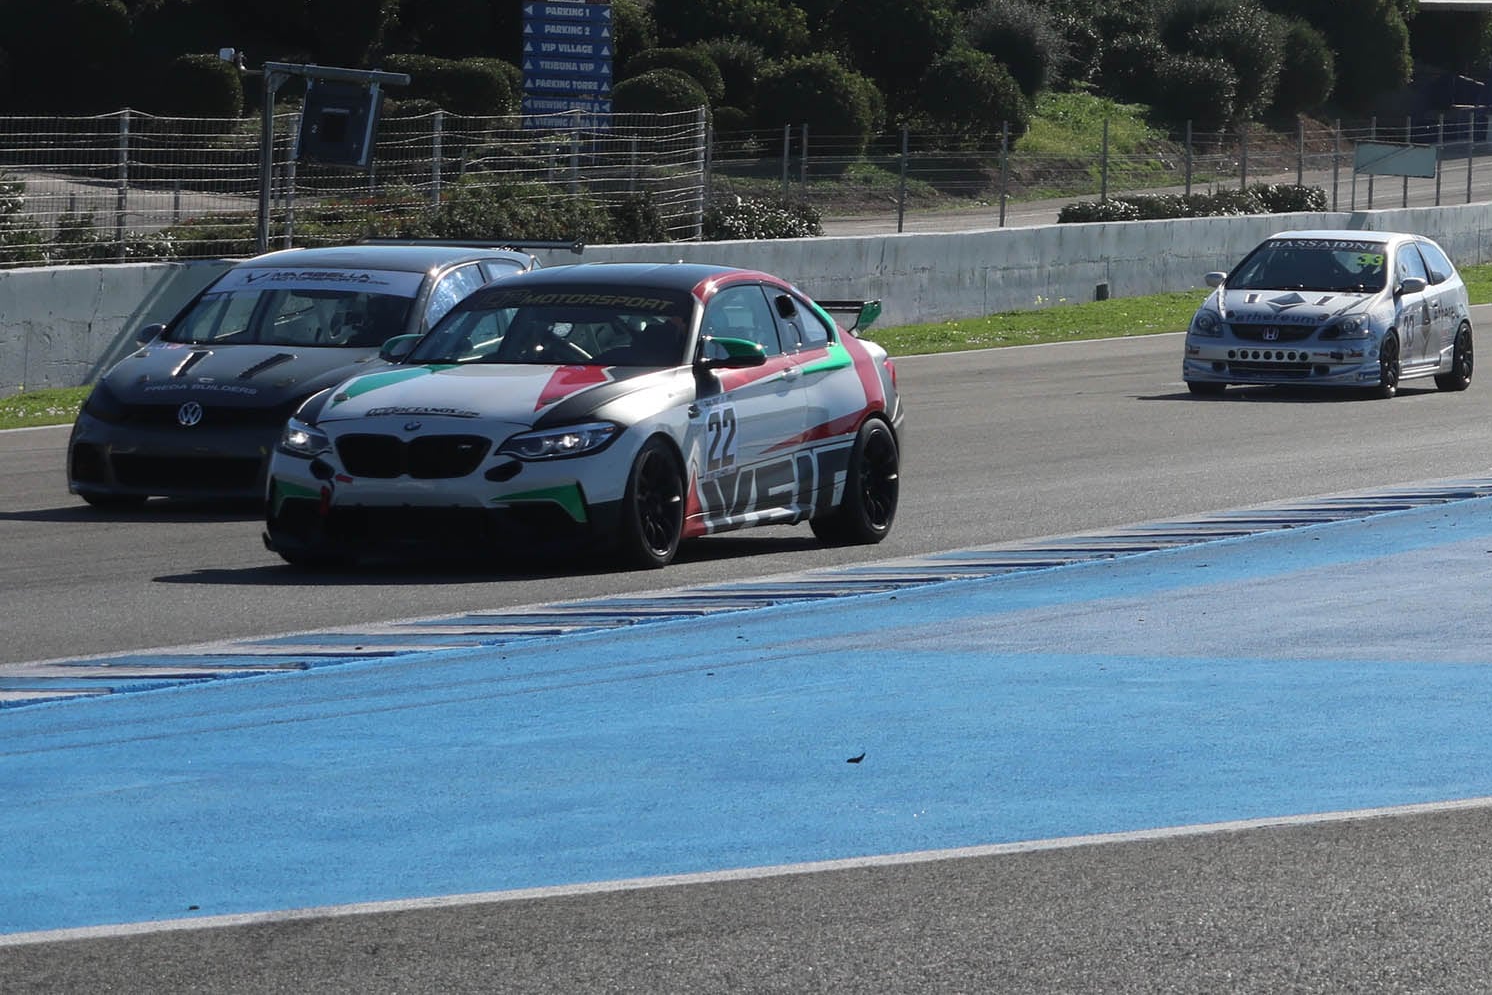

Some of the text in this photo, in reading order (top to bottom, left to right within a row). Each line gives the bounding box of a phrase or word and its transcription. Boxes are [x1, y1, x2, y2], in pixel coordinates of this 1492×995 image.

[545, 7, 590, 17] PARKING 1
[544, 25, 590, 35] PARKING 2
[541, 43, 593, 54] VIP VILLAGE
[540, 61, 595, 71] TRIBUNA VIP
[535, 79, 599, 90] PARKING TORRE
[1357, 253, 1384, 266] 33
[522, 292, 674, 311] MOTORSPORT
[708, 407, 737, 471] 22
